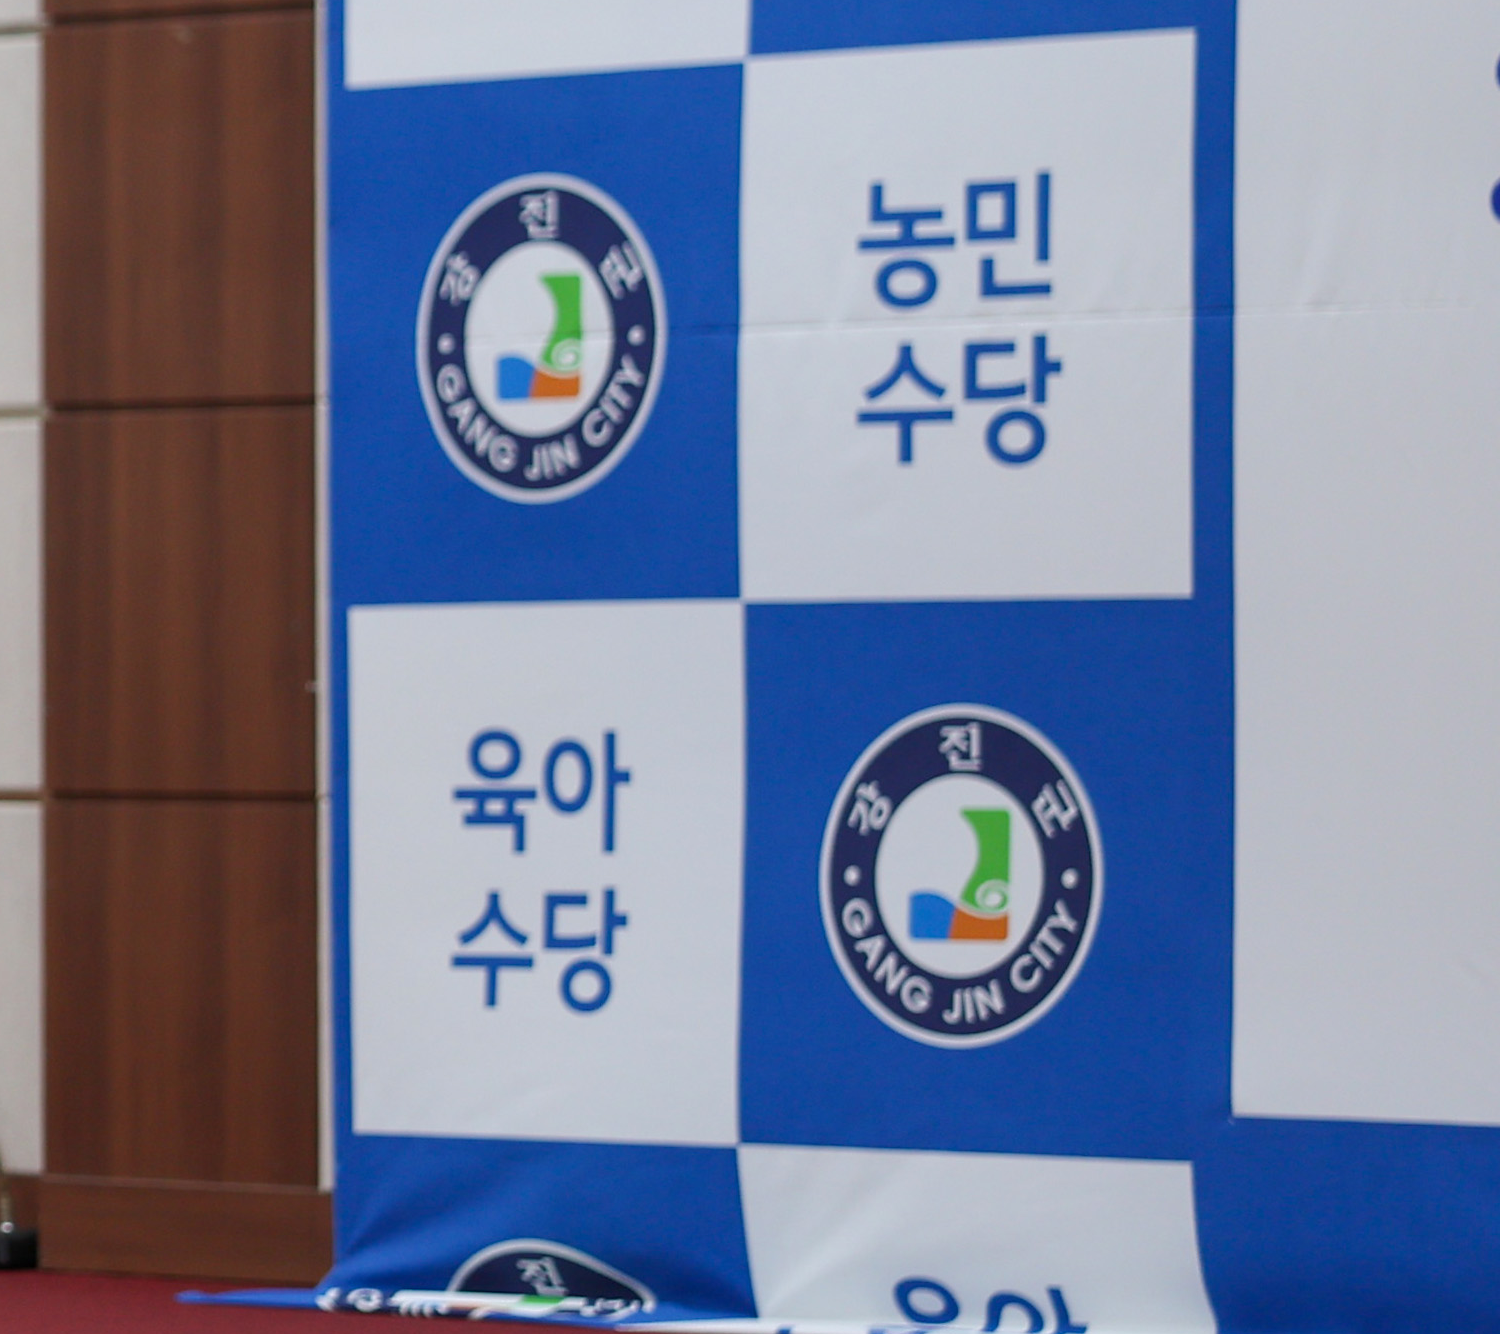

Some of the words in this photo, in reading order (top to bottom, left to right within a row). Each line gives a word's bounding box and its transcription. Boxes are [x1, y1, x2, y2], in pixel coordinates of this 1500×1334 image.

[856, 168, 1054, 310] 농민
[437, 363, 520, 472] GANG
[523, 433, 581, 482] JIN
[581, 352, 645, 448] CITY
[855, 332, 1063, 467] 수당
[451, 727, 632, 855] 육아
[450, 886, 628, 1014] 수당
[841, 897, 933, 1014] GANG
[942, 978, 1006, 1025] JIN
[1009, 899, 1077, 994] CITY
